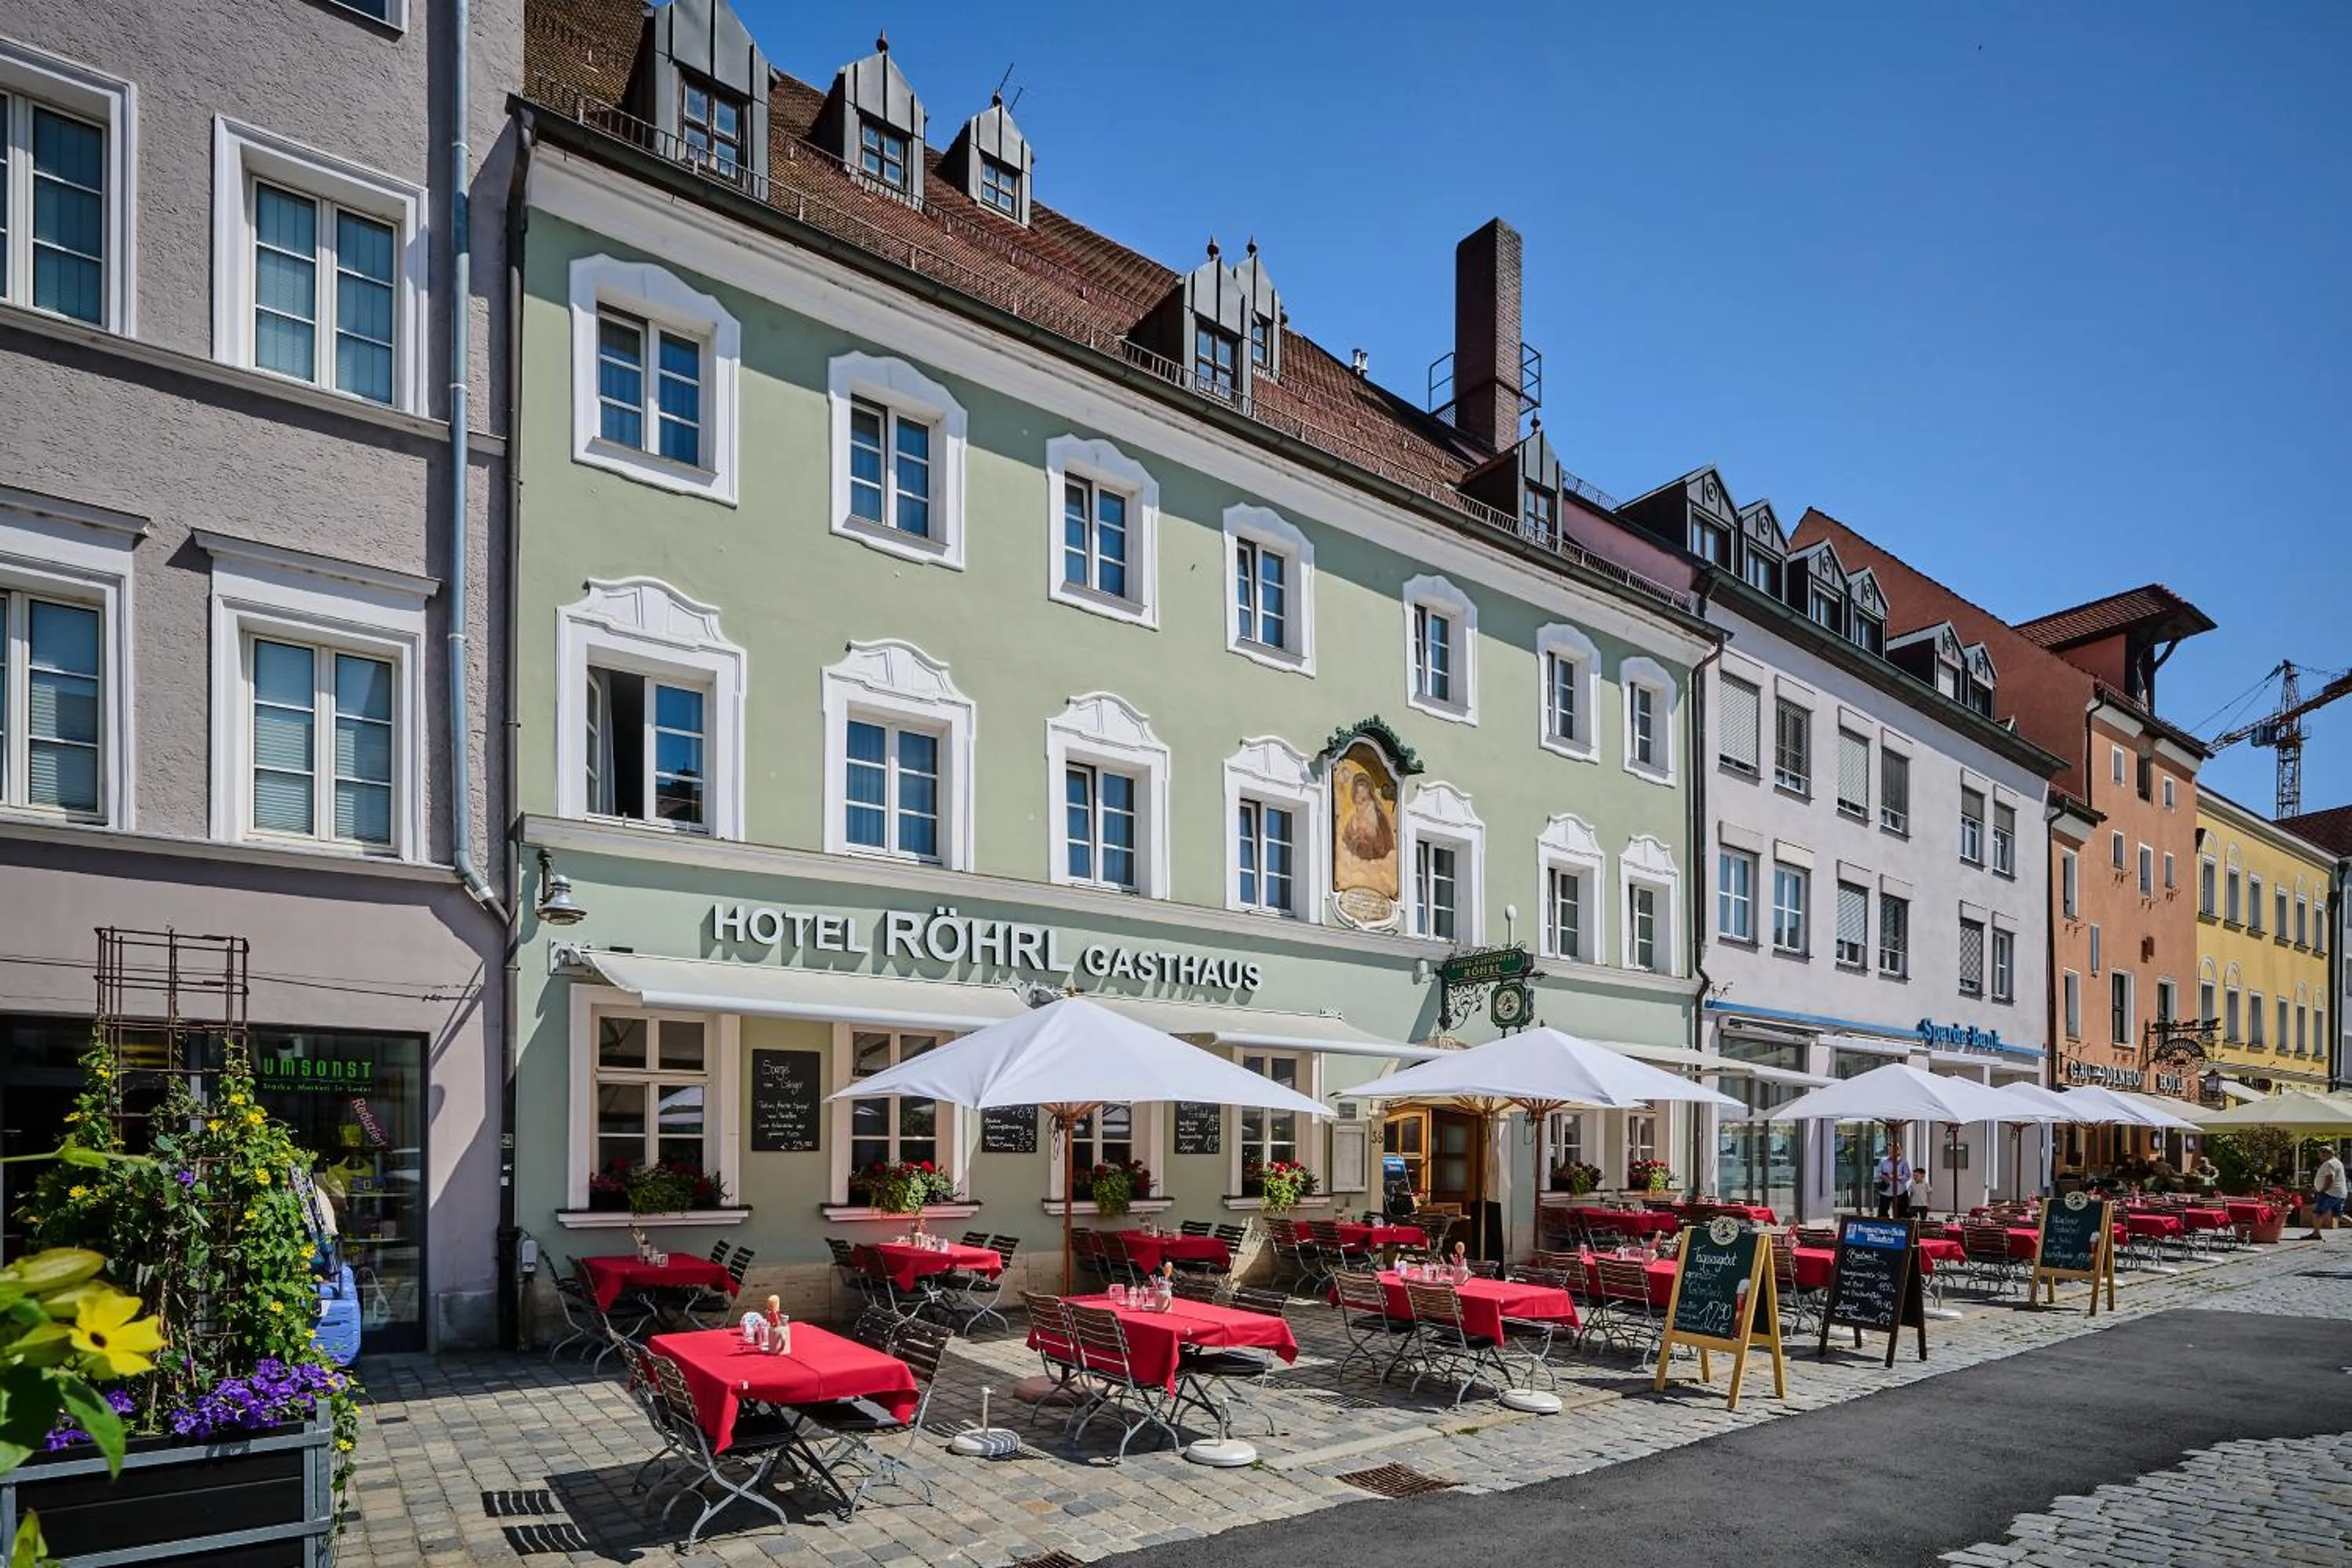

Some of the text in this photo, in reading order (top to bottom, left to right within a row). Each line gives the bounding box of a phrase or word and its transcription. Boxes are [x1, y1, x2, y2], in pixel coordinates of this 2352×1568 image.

[713, 902, 1263, 991] HOTEL RÖHRL GASTHAUS
